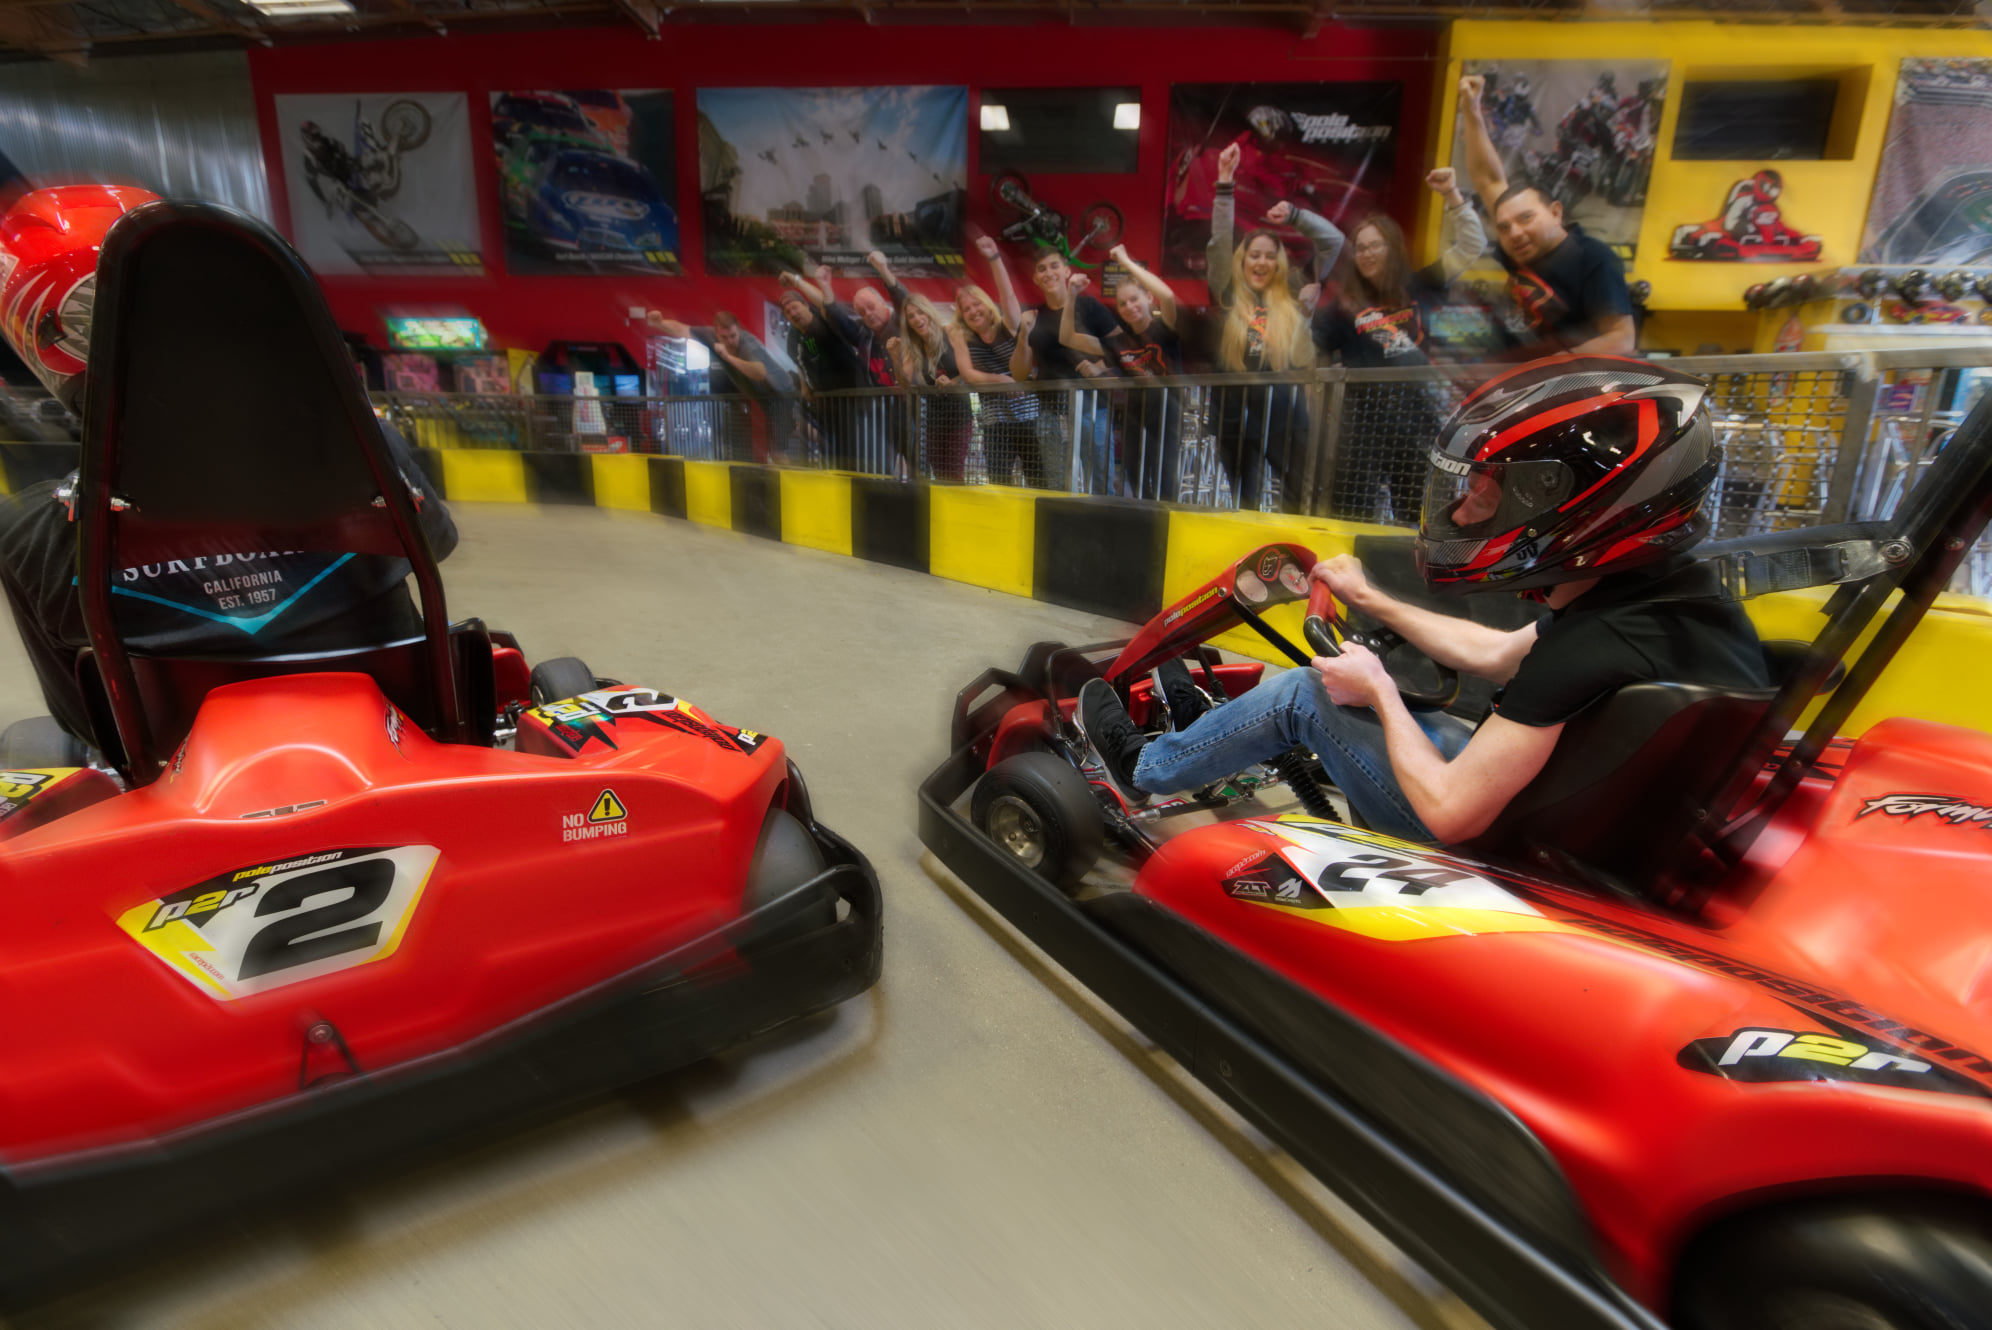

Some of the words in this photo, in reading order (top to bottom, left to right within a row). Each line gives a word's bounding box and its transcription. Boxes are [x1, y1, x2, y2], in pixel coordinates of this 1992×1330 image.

[203, 570, 283, 595] CALIFORNIA
[218, 595, 245, 611] EST.
[248, 588, 277, 605] 1957
[562, 813, 584, 829] NO
[562, 822, 627, 842] BUMPING
[232, 851, 343, 882] poleposition
[1317, 854, 1476, 896] 24
[146, 883, 258, 931] p2r
[237, 858, 396, 982] 2
[1718, 1030, 1932, 1074] p2r
